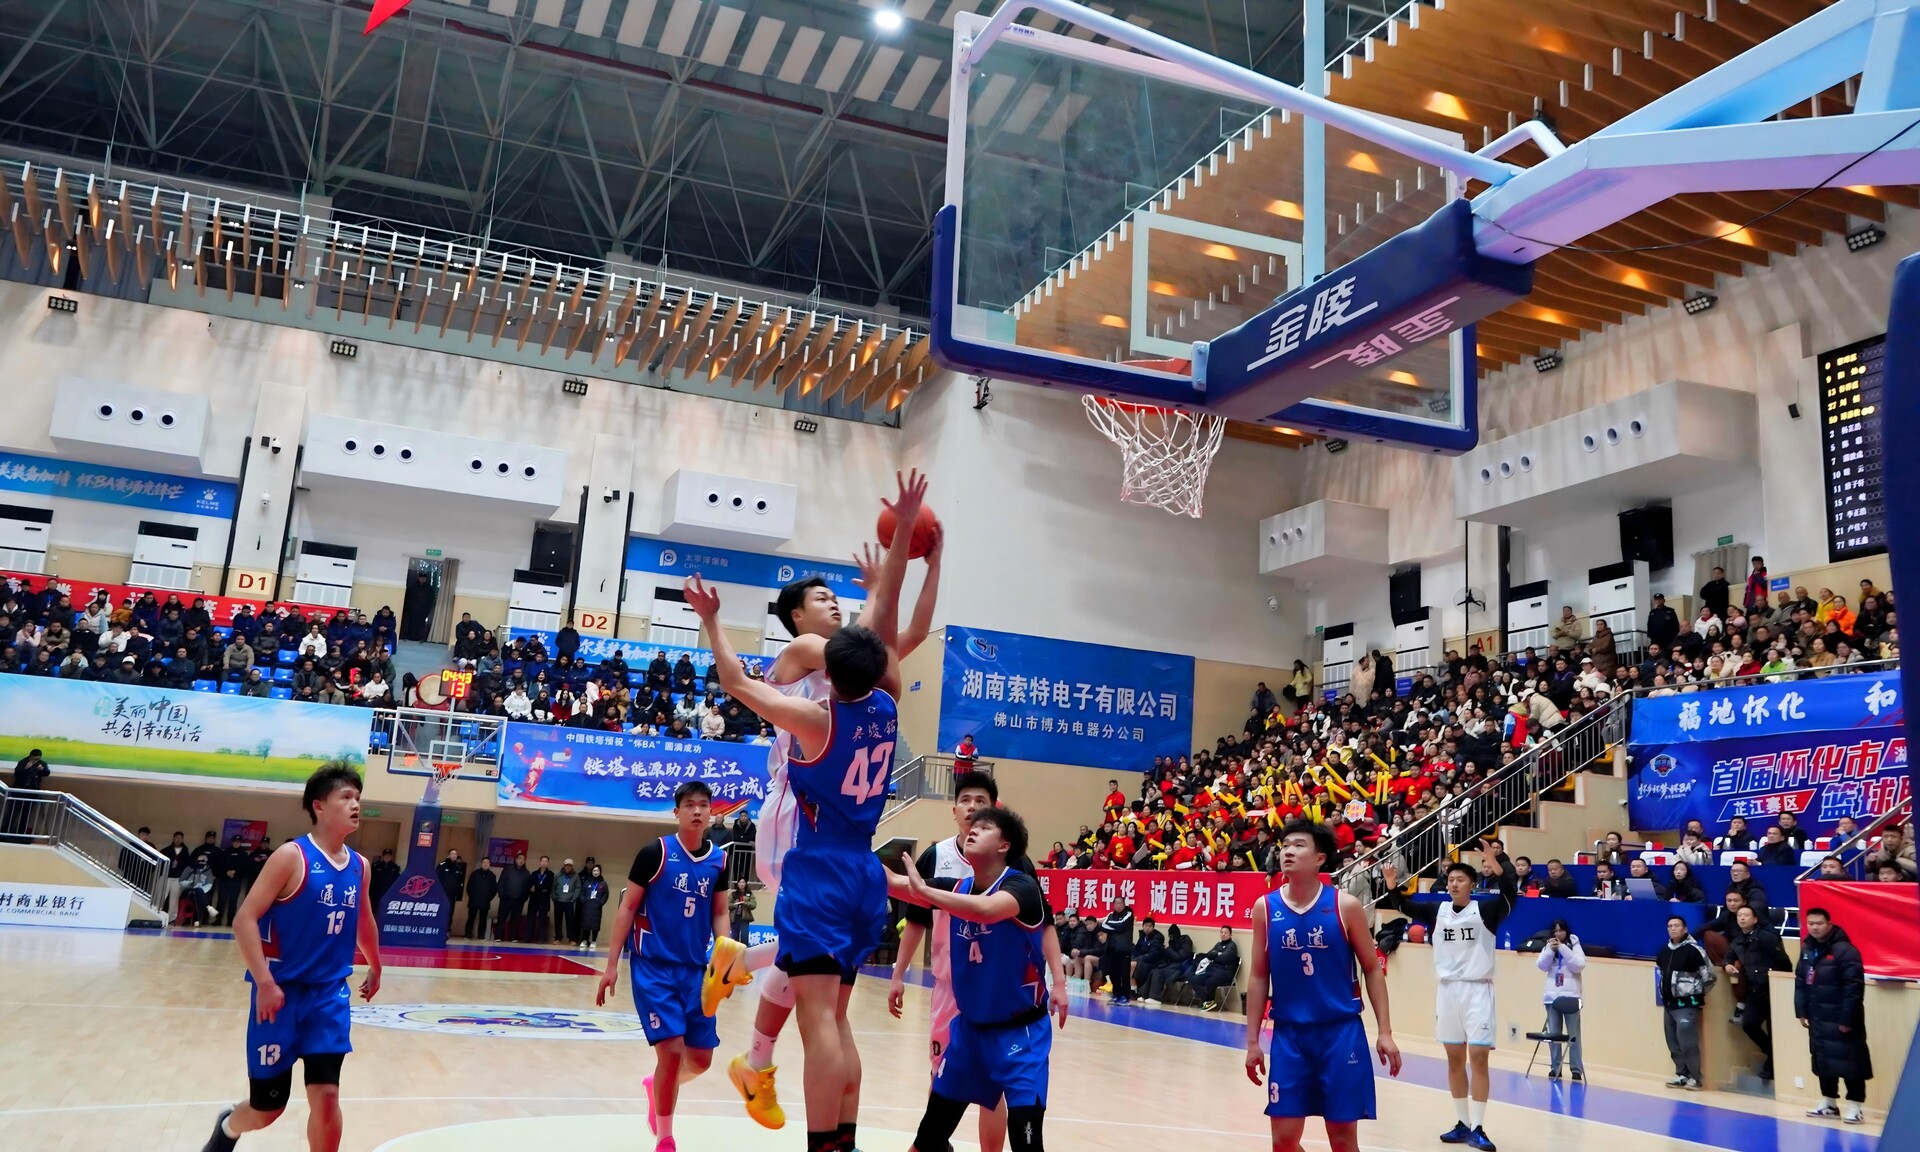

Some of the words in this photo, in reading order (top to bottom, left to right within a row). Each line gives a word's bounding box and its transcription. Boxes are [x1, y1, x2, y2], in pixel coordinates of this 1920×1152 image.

[1247, 276, 1379, 372] 金陵
[1831, 457, 1836, 465] 7
[1832, 471, 1841, 480] 10
[1833, 485, 1842, 493] 11
[1834, 498, 1843, 507] 15
[1835, 513, 1843, 521] 17
[1835, 527, 1844, 536] 21
[1836, 541, 1845, 550] 77
[684, 553, 729, 567] 太平洋保险
[238, 573, 267, 591] D1
[581, 613, 608, 630] D2
[1475, 635, 1494, 653] A1
[441, 669, 473, 685] 04:43
[451, 681, 466, 698] 13
[961, 668, 1178, 721] 湖南索特电子有限公司
[112, 695, 188, 724] 美丽中国
[1678, 691, 1807, 732] 福地怀化
[101, 719, 202, 746] 共创幸福生活
[993, 711, 1145, 743] 佛山市博为电器分公司
[583, 755, 744, 778] 铁塔能源助力芷江
[840, 741, 895, 806] 42
[1709, 741, 1885, 797] 首届怀化市
[1733, 794, 1799, 816] 芷江赛区
[317, 883, 357, 909] 通道
[672, 872, 709, 898] 通道
[387, 900, 440, 912] 金陵体育
[683, 896, 696, 918] 5
[1066, 877, 1136, 911] 情系中华
[1150, 879, 1235, 918] 诚信为民
[6, 907, 56, 916] COMMERCIAL
[326, 911, 346, 936] 13
[1442, 927, 1476, 942] 芷江
[1281, 926, 1330, 950] 通道
[968, 941, 983, 964] 4
[1300, 952, 1315, 977] 3
[649, 1012, 661, 1030] 5
[257, 1043, 281, 1066] 13
[1270, 1082, 1280, 1104] 3
